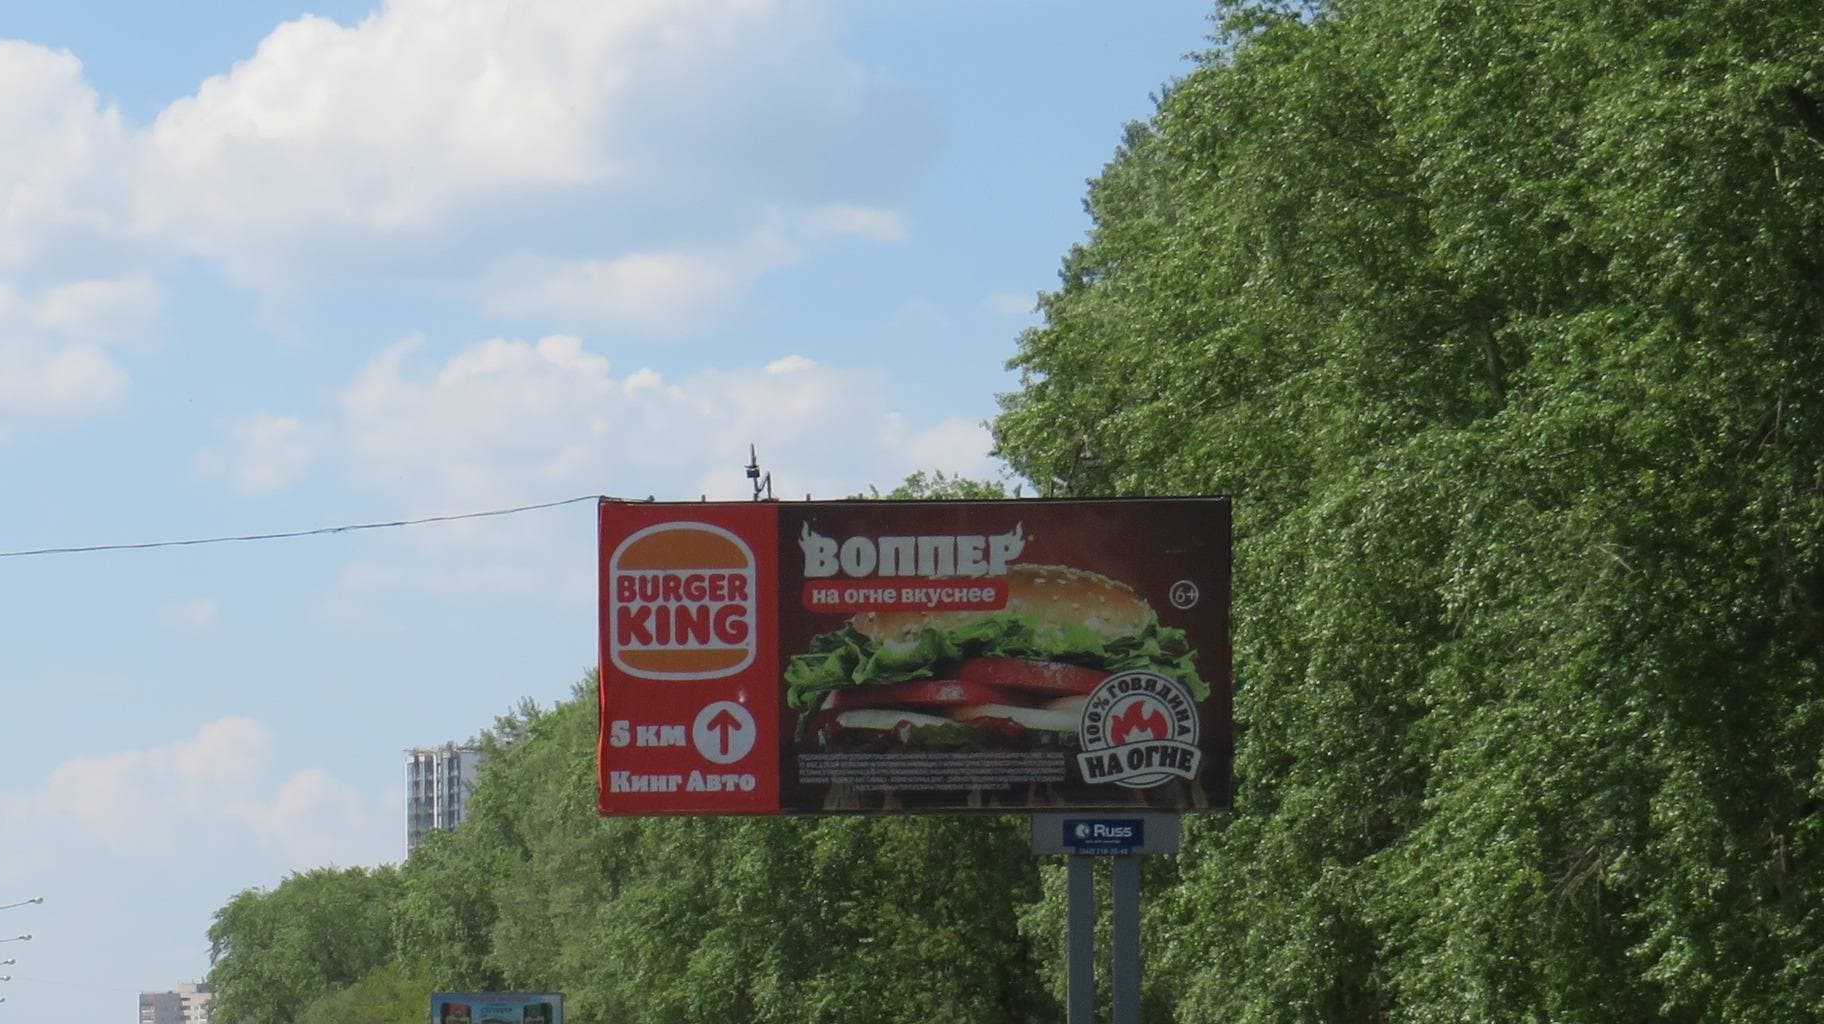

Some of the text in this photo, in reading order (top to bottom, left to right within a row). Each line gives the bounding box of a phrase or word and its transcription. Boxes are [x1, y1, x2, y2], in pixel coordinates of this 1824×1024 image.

[798, 520, 1025, 577] ВОППЕР
[617, 573, 748, 603] BURGER
[812, 587, 996, 608] на огне вкуснее
[1176, 587, 1196, 602] 6+
[617, 604, 748, 645] KING
[1107, 677, 1191, 737] ГОВЯДИНА
[610, 720, 687, 747] 5 км
[1085, 752, 1124, 778] НА
[1126, 745, 1194, 772] ОГНЕ
[610, 770, 756, 793] Кинг Авто
[1093, 824, 1133, 837] Russ
